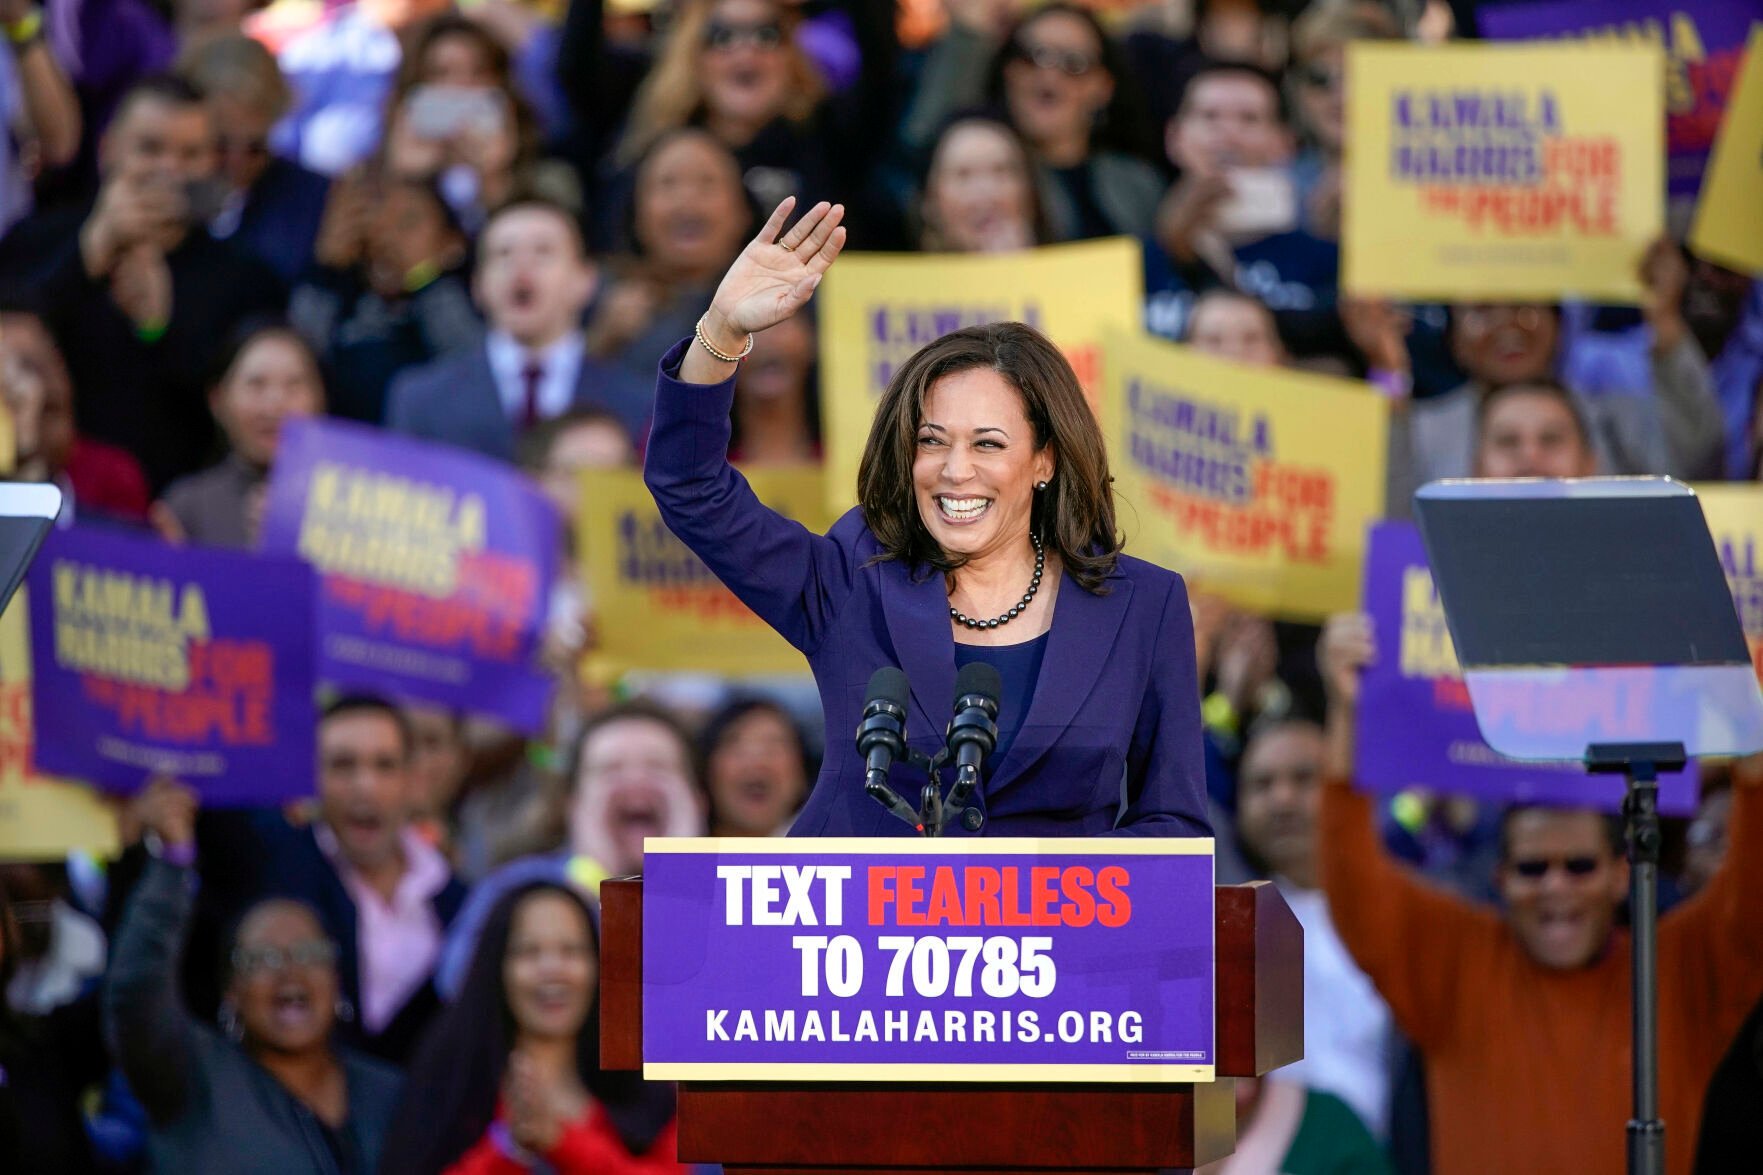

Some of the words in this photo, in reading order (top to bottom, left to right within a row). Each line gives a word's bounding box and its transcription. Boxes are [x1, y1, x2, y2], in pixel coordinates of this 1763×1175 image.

[716, 865, 852, 926] TEXT
[867, 865, 1132, 928] FEARLESS
[792, 934, 864, 998] TO
[877, 935, 1057, 998] 70785
[706, 1008, 1143, 1044] KAMALAHARRIS.ORG
